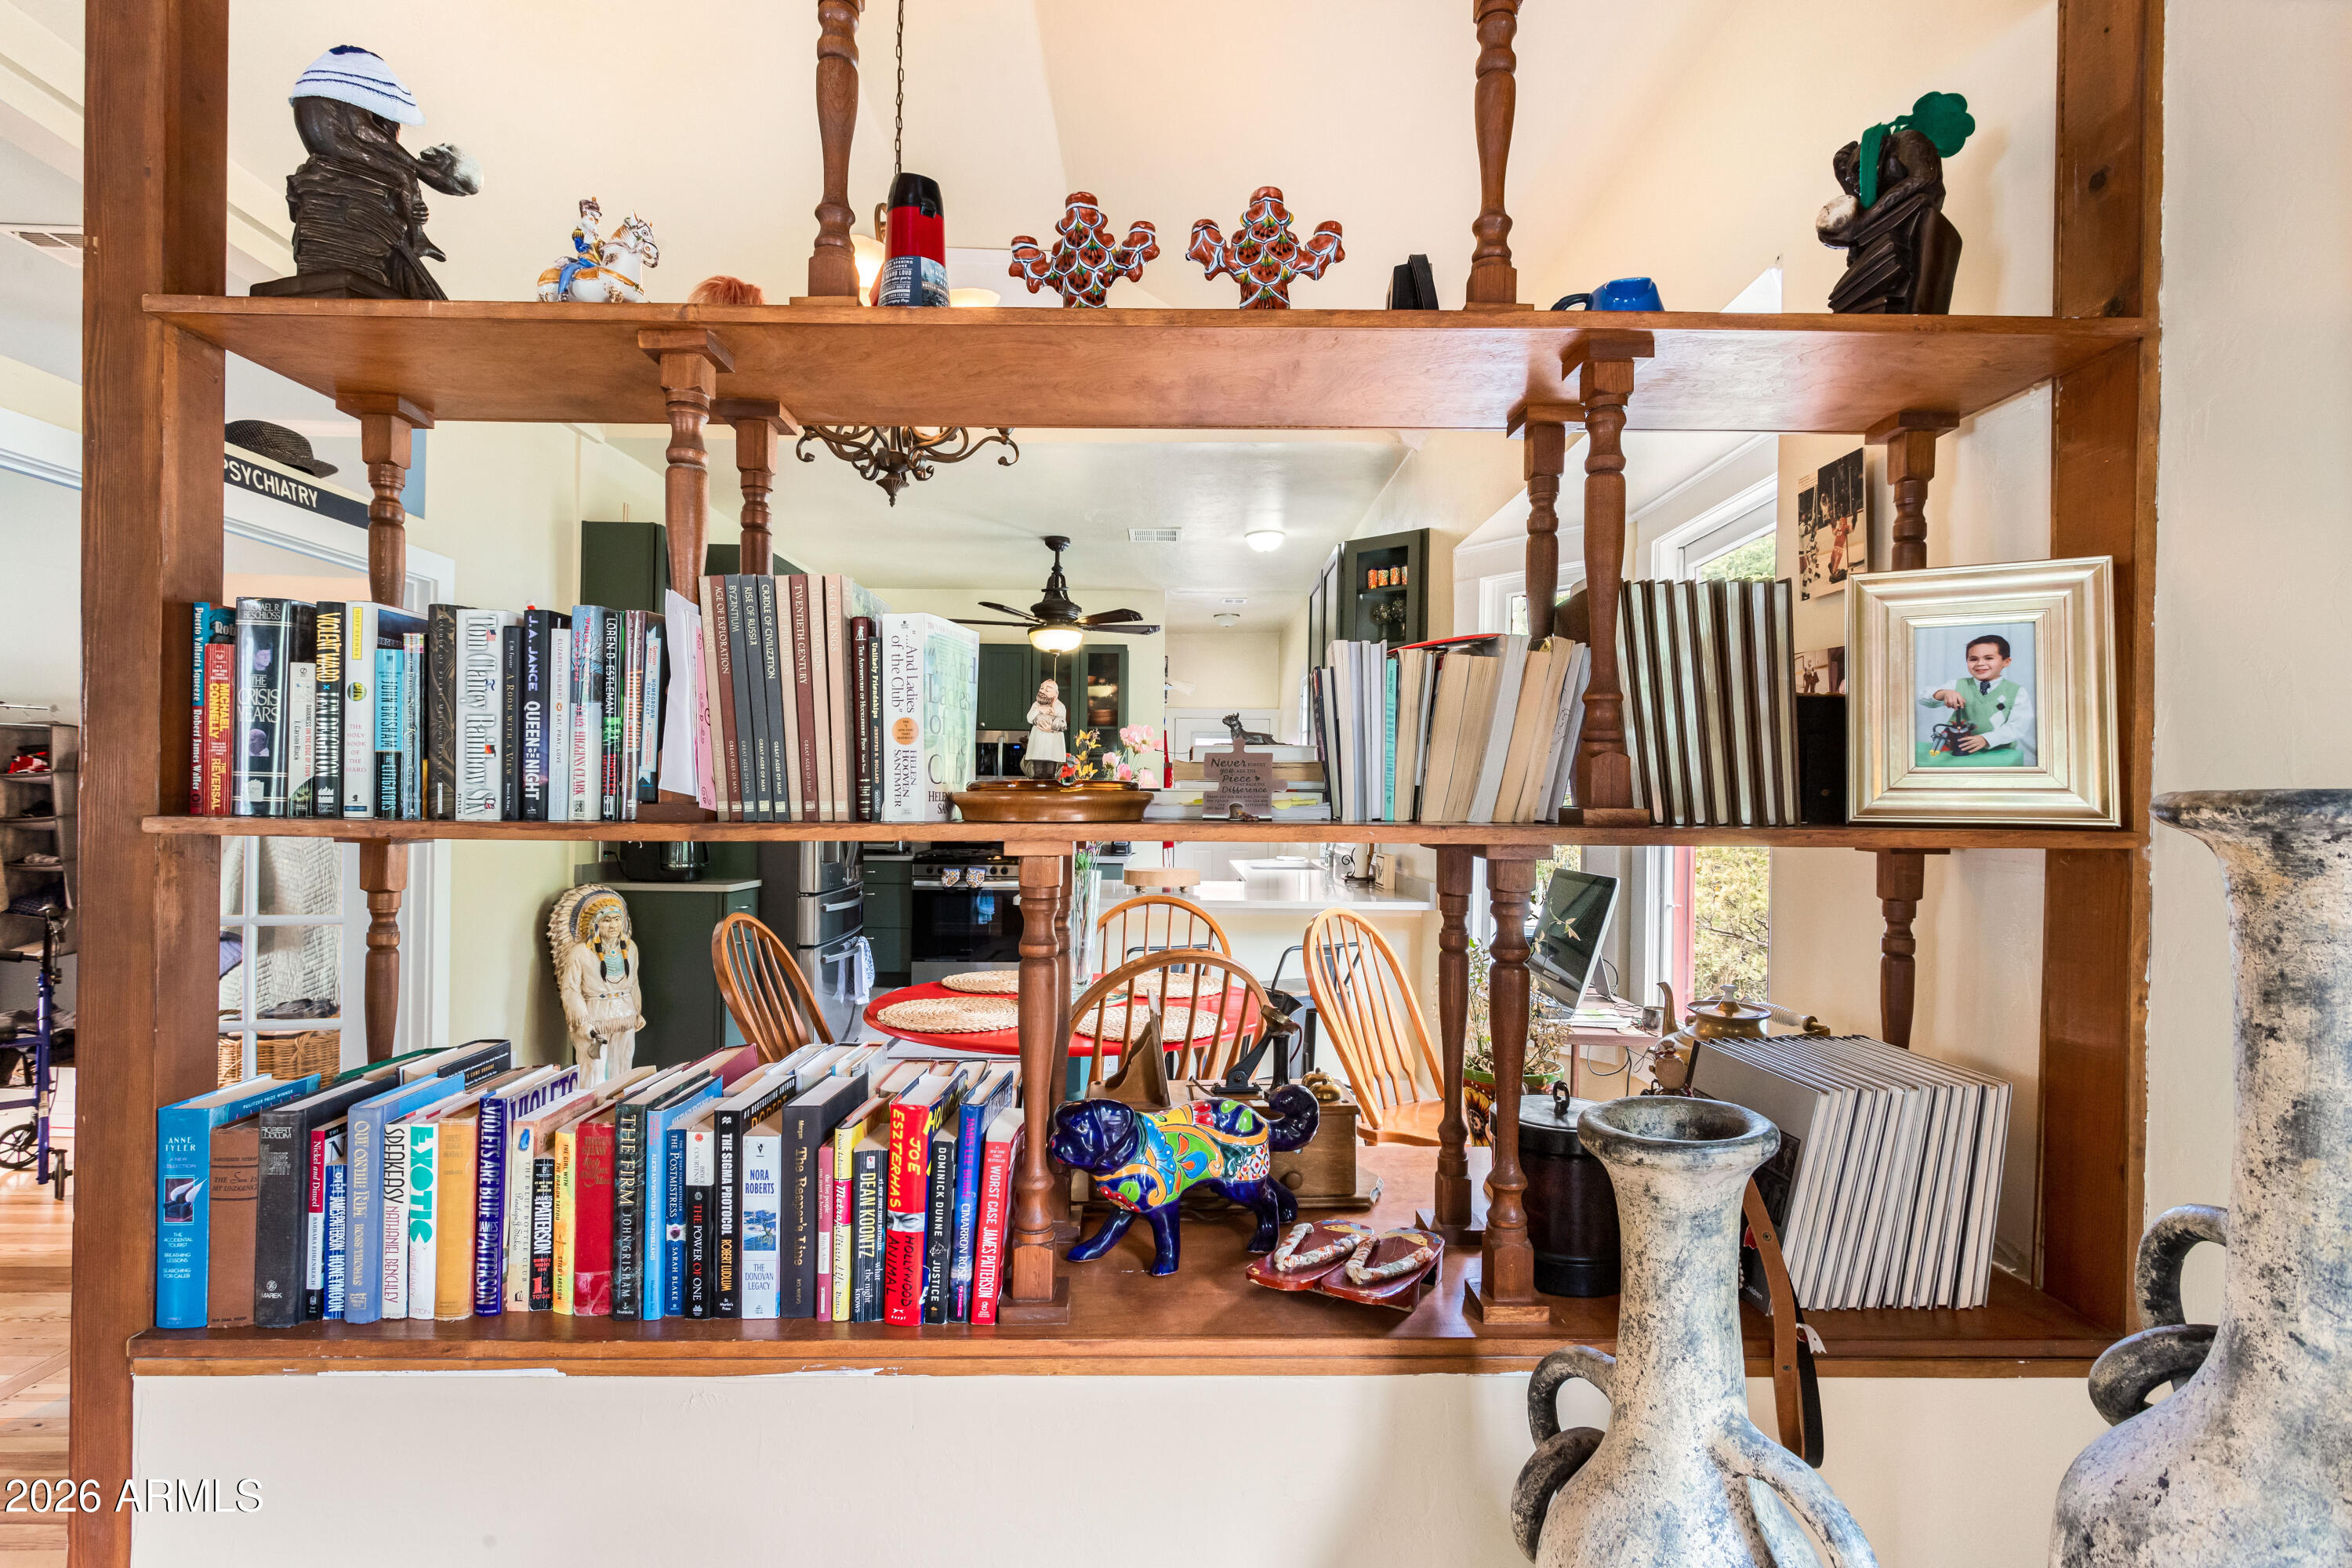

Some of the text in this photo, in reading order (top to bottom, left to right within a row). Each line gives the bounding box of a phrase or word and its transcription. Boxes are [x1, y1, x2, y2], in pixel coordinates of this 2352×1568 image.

[244, 611, 281, 620] BESCHLOSS
[467, 615, 496, 651] Tom
[715, 586, 730, 674] AGE OF EXPLORATION
[728, 585, 740, 633] BYZANTIUM
[745, 586, 757, 646] RISE OF RUSSIA
[762, 584, 775, 679] CRADLE OF CIVILIZATION
[794, 584, 808, 684] TWENTIETH CENTURY
[192, 607, 204, 790] Puerto Vallarta Squeeze Robert James Waller
[220, 684, 229, 731] MICHAEL
[238, 689, 279, 705] CRISIS
[250, 676, 267, 686] THE
[315, 612, 342, 777] VIOLENT WARD LEN DEIGHTON
[459, 654, 496, 710] Clancy
[209, 683, 220, 739] CONNELLY
[238, 706, 279, 723] YEARS
[381, 681, 397, 747] JOHN GRISHAM
[525, 701, 540, 747] QUEEN
[465, 714, 496, 784] Rainbow
[902, 750, 910, 797] HOOVEN
[1211, 758, 1246, 768] Never
[211, 758, 220, 811] REVERSAL
[524, 760, 540, 800] NIGHT
[893, 750, 902, 808] SANTMYER
[243, 1099, 263, 1109] PULITZER
[264, 1094, 276, 1103] PRIZE
[383, 1128, 405, 1204] SPEAKEASY
[619, 1114, 637, 1207] THE FIRM
[750, 1170, 769, 1181] NORA
[889, 1109, 905, 1208] ESZTERHAS
[907, 1138, 921, 1176] JOE
[961, 1116, 975, 1200] JAMES LEE BURKE
[312, 1181, 321, 1207] Dimed
[329, 1196, 345, 1214] JAMES
[409, 1127, 434, 1243] EXOTIC
[670, 1152, 680, 1218] POSTMISTRESS
[746, 1183, 775, 1194] ROBERTS
[934, 1147, 947, 1237] DOMINICK DUNNE
[329, 1215, 345, 1250] PATTERSON
[478, 1221, 498, 1232] JAMES
[533, 1201, 552, 1254] PATTERSON
[720, 1133, 732, 1292] THE SIGMA PROTOCOL ROBERT LUDLUM
[858, 1172, 876, 1258] DEAN KOONTZ
[959, 1203, 971, 1254] CIMARRON
[978, 1166, 1002, 1298] WORST CASE JAMES PATTERSON
[384, 1206, 400, 1303] NATHANIEL BENCHLEY
[477, 1232, 498, 1305] PATTERSON
[693, 1204, 702, 1301] THE POWER OF ONE
[745, 1272, 774, 1281] DONOVAN
[753, 1264, 764, 1272] THE
[874, 1261, 884, 1281] what
[886, 1236, 900, 1296] ANIMAL
[901, 1236, 915, 1307] HOLLYWOOD
[956, 1255, 969, 1280] ROSE
[328, 1254, 345, 1312] HONEYMOON
[748, 1281, 771, 1290] LEGACY
[855, 1288, 864, 1313] knows
[931, 1260, 941, 1302] JUSTICE
